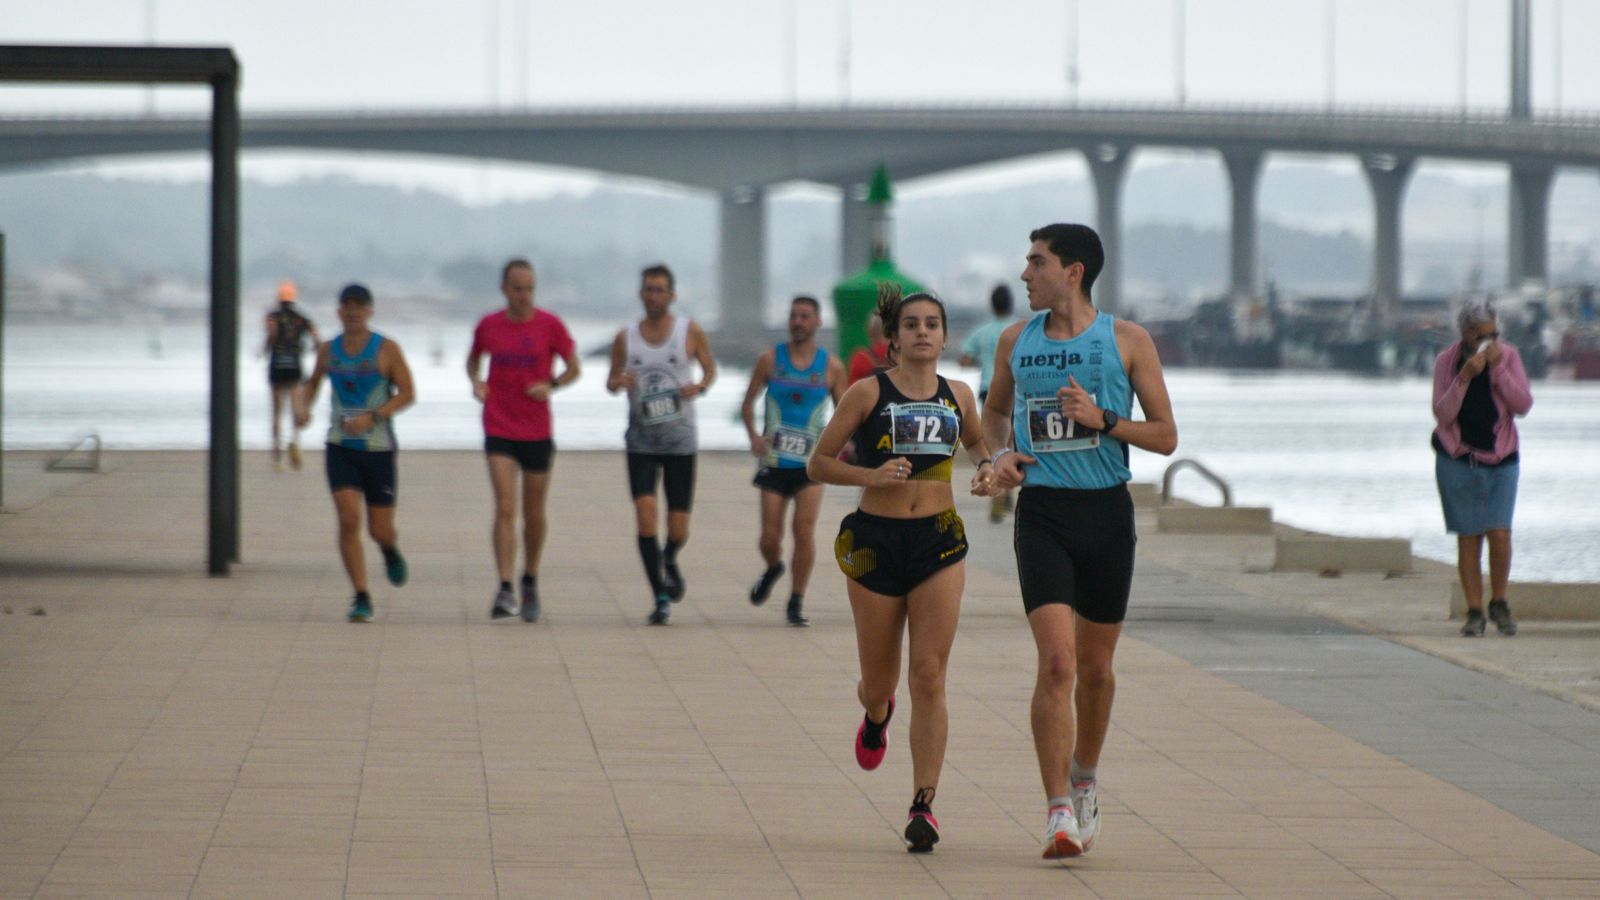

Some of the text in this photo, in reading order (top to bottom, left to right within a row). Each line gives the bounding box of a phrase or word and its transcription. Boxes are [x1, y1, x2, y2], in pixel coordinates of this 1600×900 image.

[1019, 349, 1083, 370] nerja
[914, 416, 942, 443] 72
[1046, 412, 1075, 440] 67
